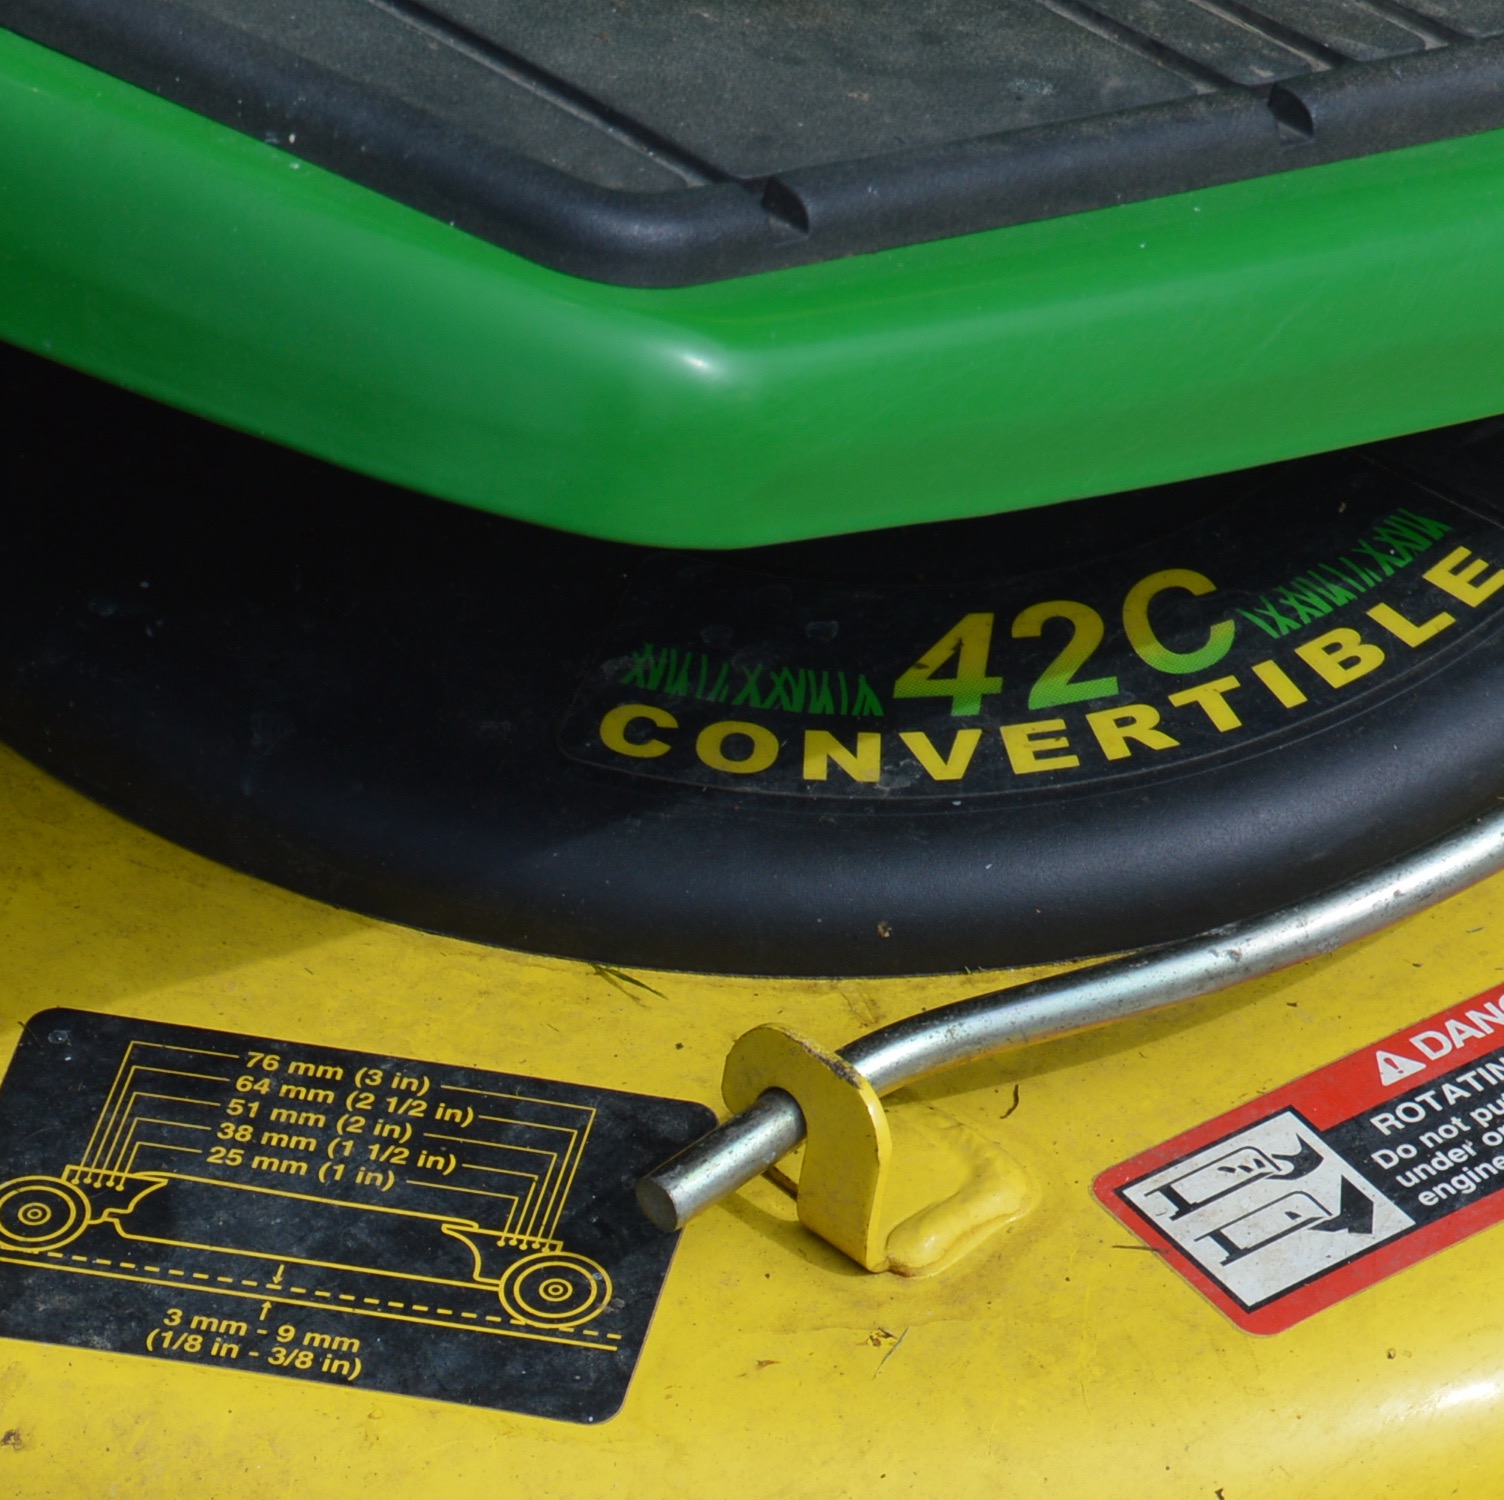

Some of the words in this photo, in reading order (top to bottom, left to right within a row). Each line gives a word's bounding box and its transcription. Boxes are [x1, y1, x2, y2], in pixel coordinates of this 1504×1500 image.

[893, 569, 1236, 718] 42C
[247, 1052, 280, 1071] 76
[288, 1061, 344, 1080] mm
[355, 1067, 383, 1088] (3
[391, 1072, 430, 1096] in)
[226, 1098, 260, 1118] 51
[270, 1108, 326, 1128] mm
[336, 1114, 366, 1135] (2
[373, 1119, 412, 1144] in)
[236, 1075, 271, 1095] 64
[279, 1084, 335, 1104] mm
[346, 1091, 375, 1112] (2
[386, 1097, 428, 1117] 1/2
[435, 1103, 474, 1128] in)
[217, 1122, 254, 1142] 38
[261, 1132, 317, 1152] mm
[328, 1138, 354, 1159] (1
[368, 1144, 410, 1165] 1/2
[417, 1150, 456, 1176] in)
[1371, 1143, 1418, 1170] Do
[1419, 1116, 1471, 1149] not
[1396, 1140, 1477, 1188] under
[206, 1146, 245, 1166] 25
[251, 1156, 308, 1176] mm
[318, 1162, 345, 1183] (1
[355, 1166, 395, 1192] in)
[146, 1328, 203, 1352] (1/8
[210, 1337, 240, 1358] in
[268, 1347, 314, 1369] 3/8
[321, 1354, 362, 1381] in)
[163, 1308, 183, 1326] 3
[190, 1315, 247, 1337] mm
[276, 1325, 296, 1343] 9
[303, 1332, 360, 1353] mm
